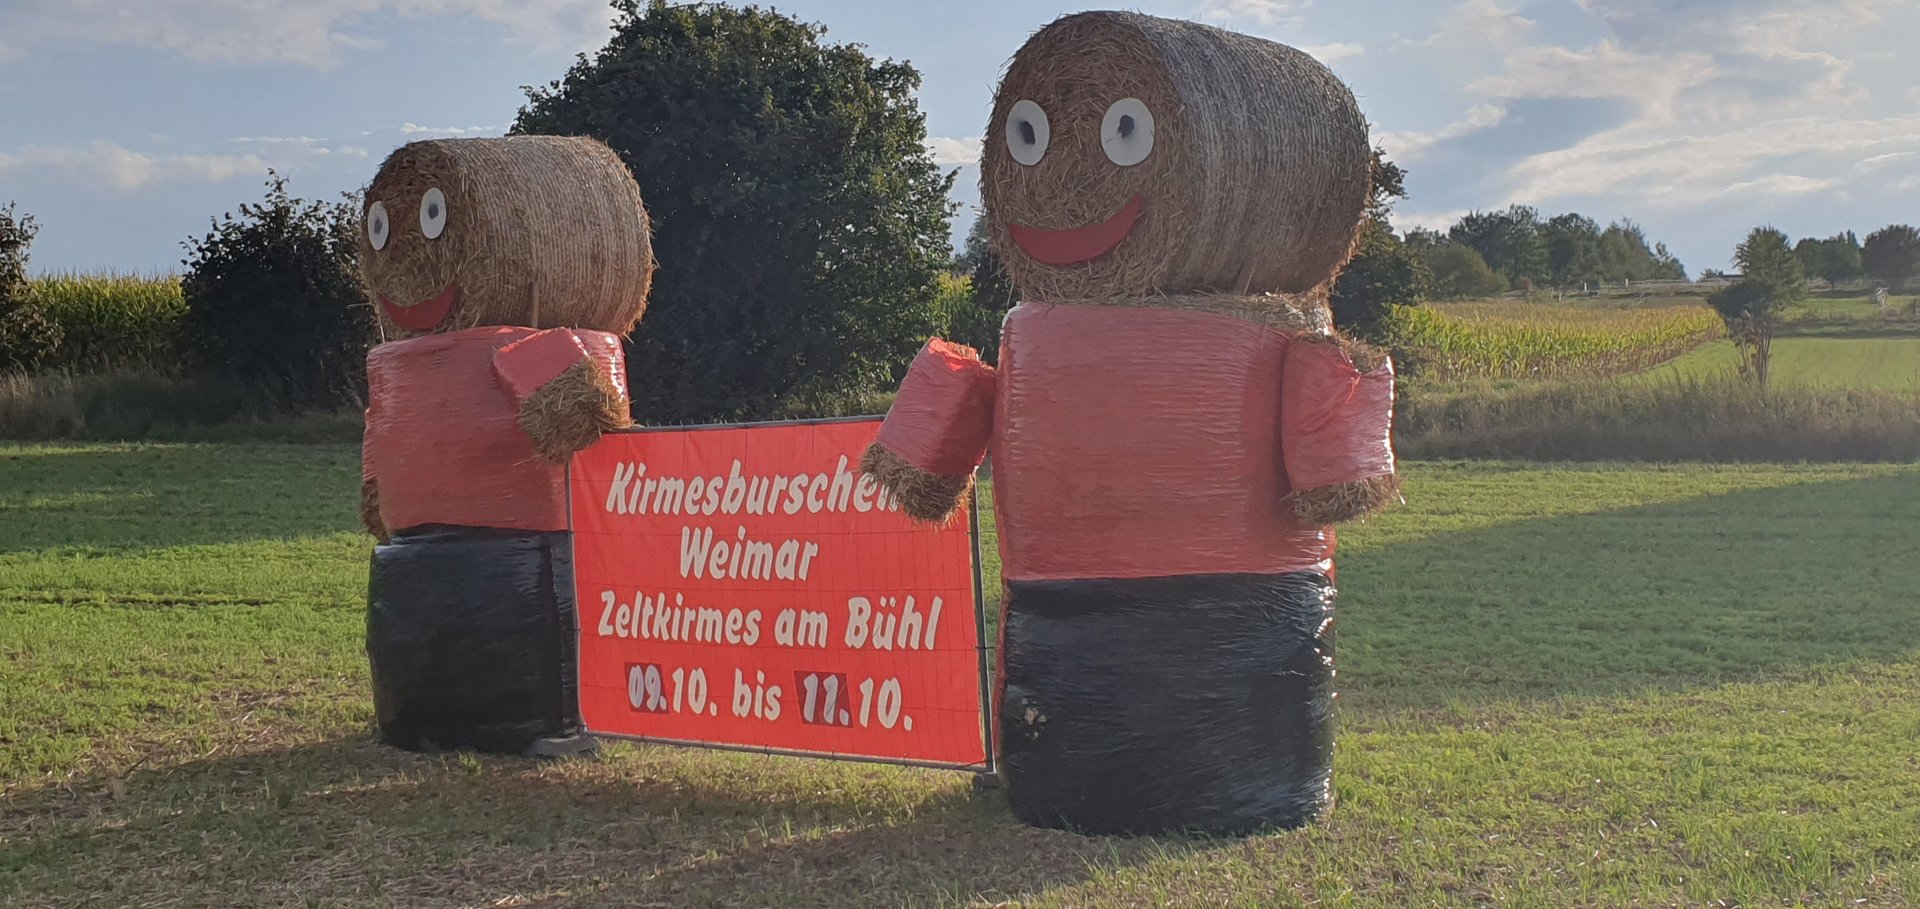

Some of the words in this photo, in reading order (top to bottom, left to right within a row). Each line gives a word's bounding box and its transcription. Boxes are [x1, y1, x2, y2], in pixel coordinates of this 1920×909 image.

[680, 526, 819, 580] Weimar
[598, 590, 761, 646] Zeltkirmes
[775, 606, 829, 648] am
[844, 594, 942, 650] Bühl
[627, 664, 718, 717] 09.10.
[732, 668, 782, 722] bis
[803, 673, 914, 731] 11.10.
